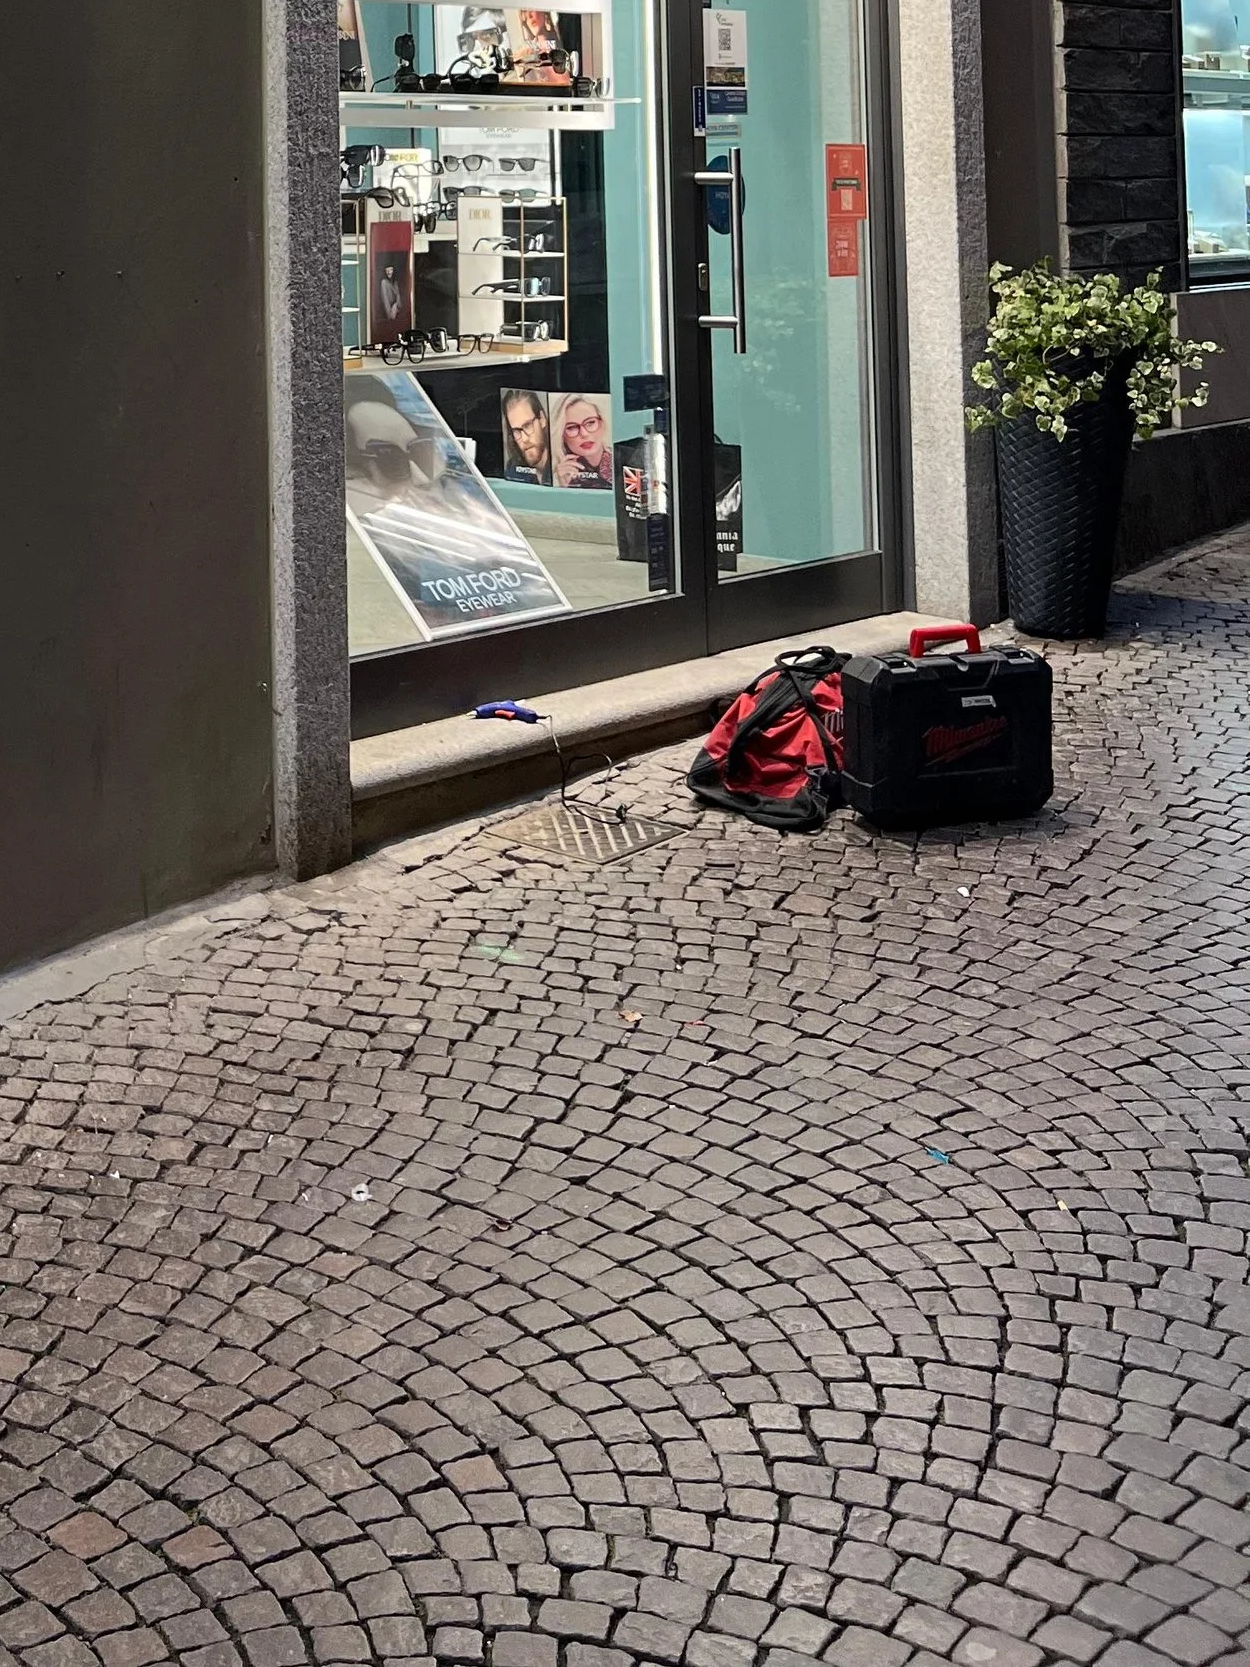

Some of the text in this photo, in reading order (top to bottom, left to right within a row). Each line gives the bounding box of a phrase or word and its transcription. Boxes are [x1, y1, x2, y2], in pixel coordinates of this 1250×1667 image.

[469, 208, 492, 220] DIOR
[717, 543, 735, 553] que
[421, 567, 521, 601] TOM FORD
[456, 591, 517, 613] EYEWEAR
